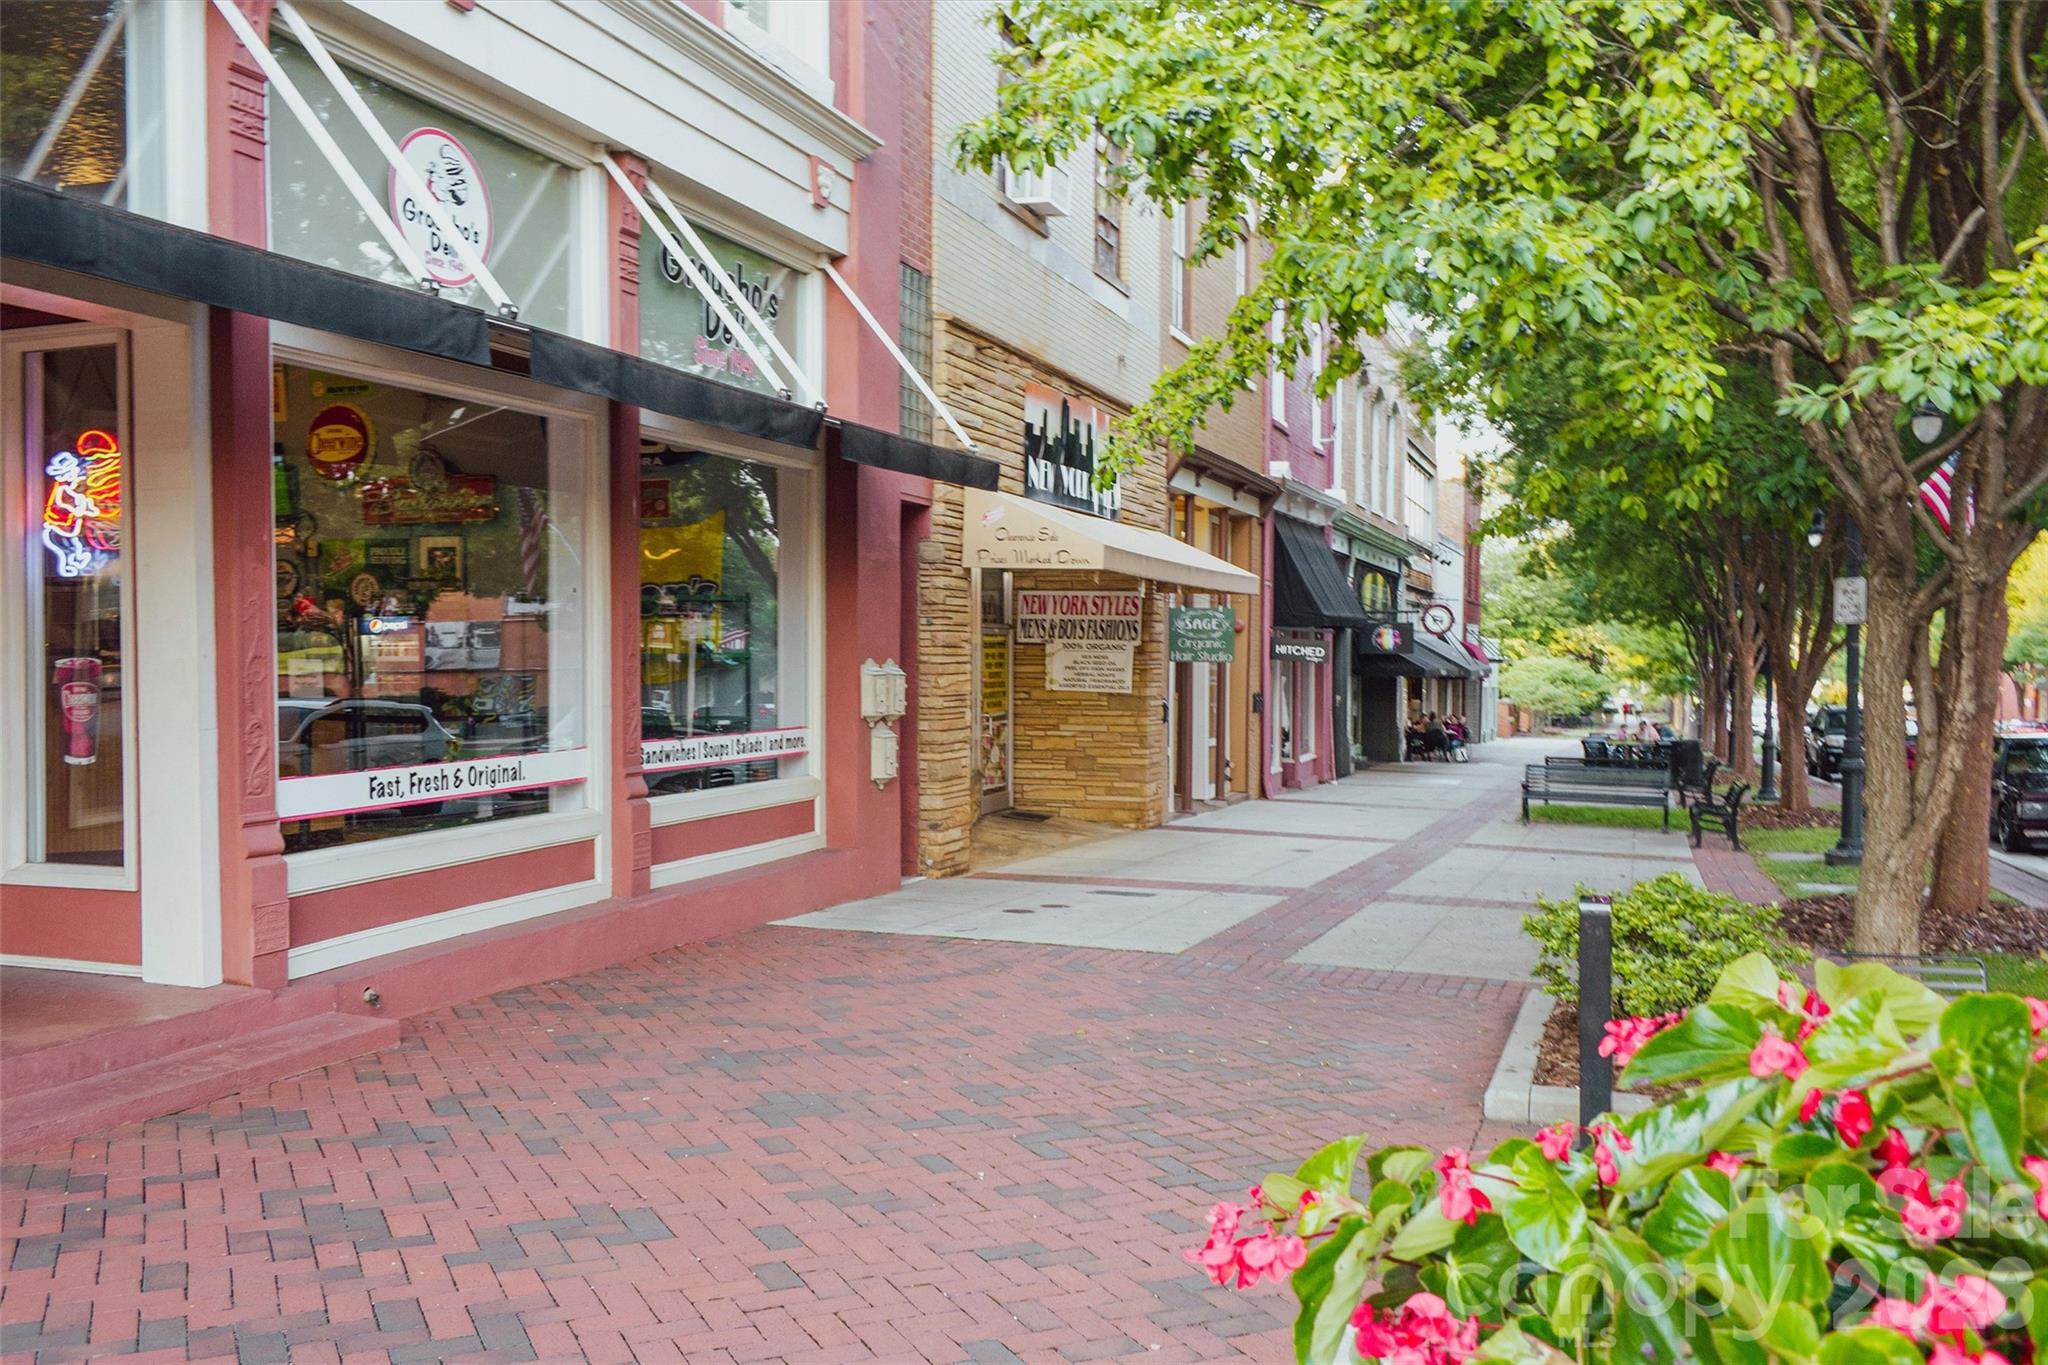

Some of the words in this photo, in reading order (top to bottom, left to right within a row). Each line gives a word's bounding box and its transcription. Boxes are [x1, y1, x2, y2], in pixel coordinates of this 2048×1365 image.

[1020, 594, 1047, 615] NEW
[1051, 594, 1088, 616] YORK
[1090, 595, 1139, 617] STYLES
[1019, 618, 1047, 639] MENS
[1047, 619, 1057, 640] &
[1058, 619, 1086, 640] BOYS
[1086, 620, 1139, 641] FASHIONS
[1184, 618, 1219, 630] SAGE
[1177, 638, 1226, 651] Organic
[1275, 644, 1326, 658] HITCHED
[1171, 651, 1195, 662] Hair
[1197, 651, 1233, 662] Studio
[640, 743, 696, 765] Sandwiches
[703, 741, 729, 760] Soups
[736, 736, 762, 755] Salads
[769, 734, 784, 750] and
[369, 775, 405, 799] Fast,
[409, 768, 449, 794] Fresh
[453, 768, 464, 788] &
[468, 760, 526, 788] Original.
